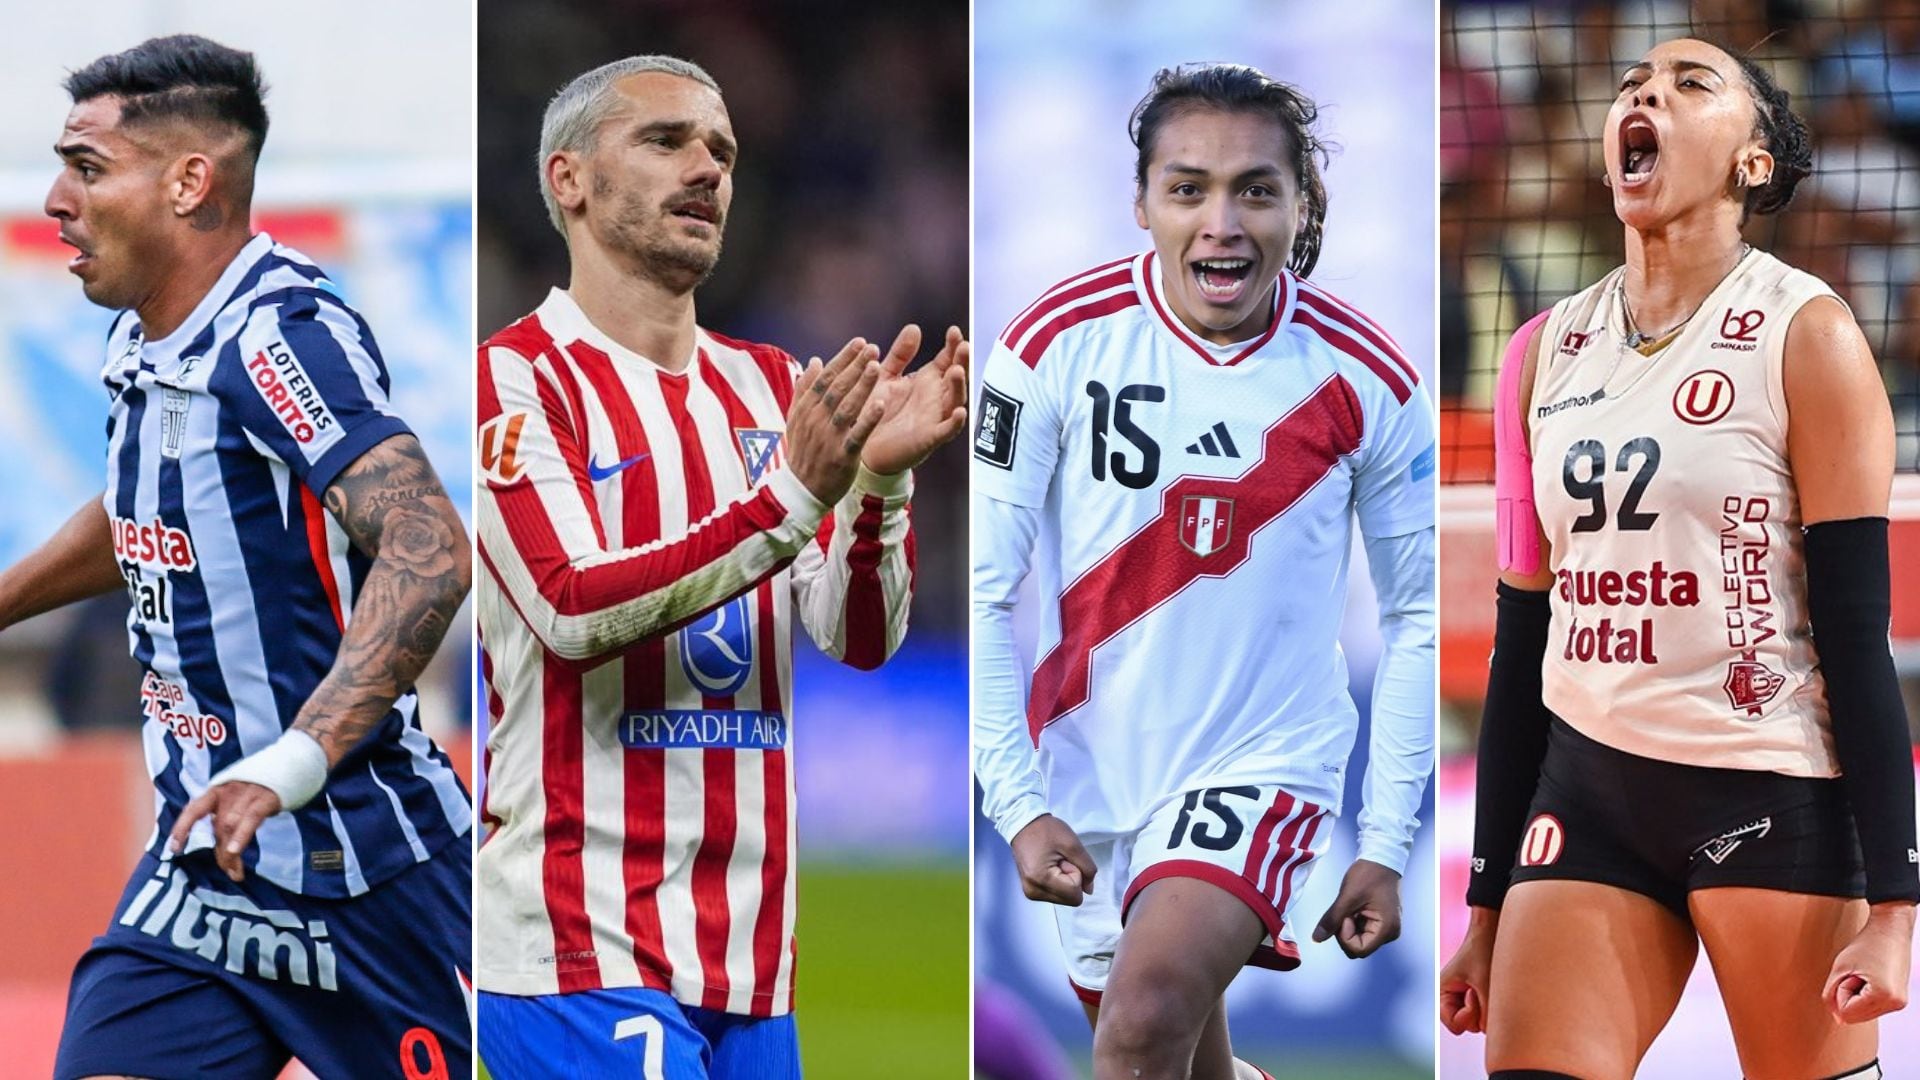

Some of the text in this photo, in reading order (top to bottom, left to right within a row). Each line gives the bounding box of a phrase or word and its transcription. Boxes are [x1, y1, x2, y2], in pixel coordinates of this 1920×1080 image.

[248, 350, 314, 443] TORITO
[1686, 379, 1723, 418] U
[1086, 380, 1166, 490] 15
[1562, 437, 1661, 533] 92
[1721, 496, 1746, 648] COLECTIVO
[1743, 498, 1777, 645] WORLD
[1564, 617, 1658, 664] total
[628, 715, 782, 745] RIYADH AIR
[1167, 785, 1261, 851] 15
[1525, 827, 1553, 865] U
[119, 861, 338, 992] ilumi
[400, 1027, 450, 1080] 9
[614, 1014, 665, 1080] 7
